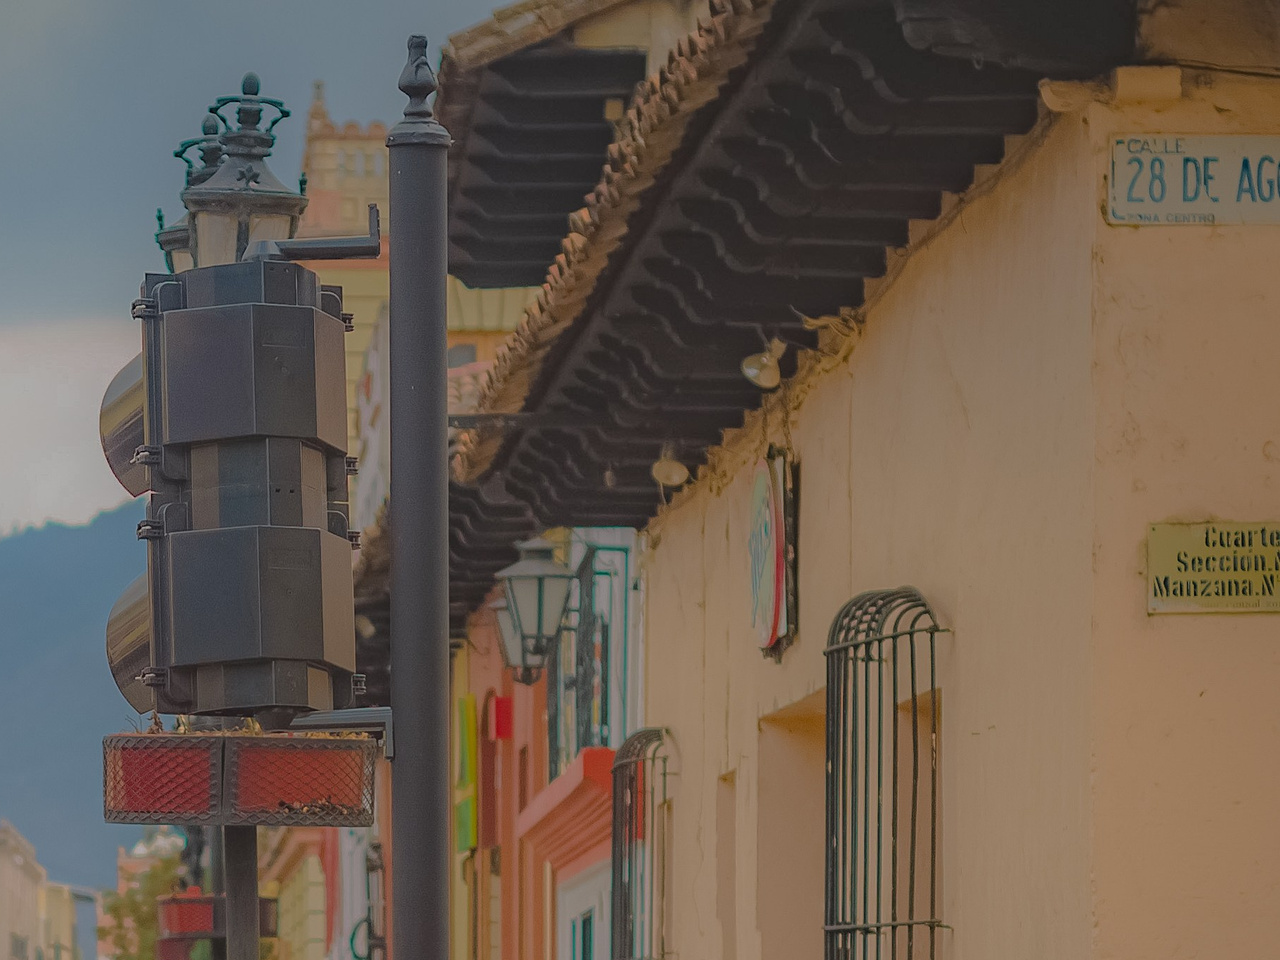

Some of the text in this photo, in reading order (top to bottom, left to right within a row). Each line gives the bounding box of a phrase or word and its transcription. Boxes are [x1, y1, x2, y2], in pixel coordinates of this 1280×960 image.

[1127, 138, 1186, 154] CALLE
[1127, 155, 1280, 203] 28 DE AG
